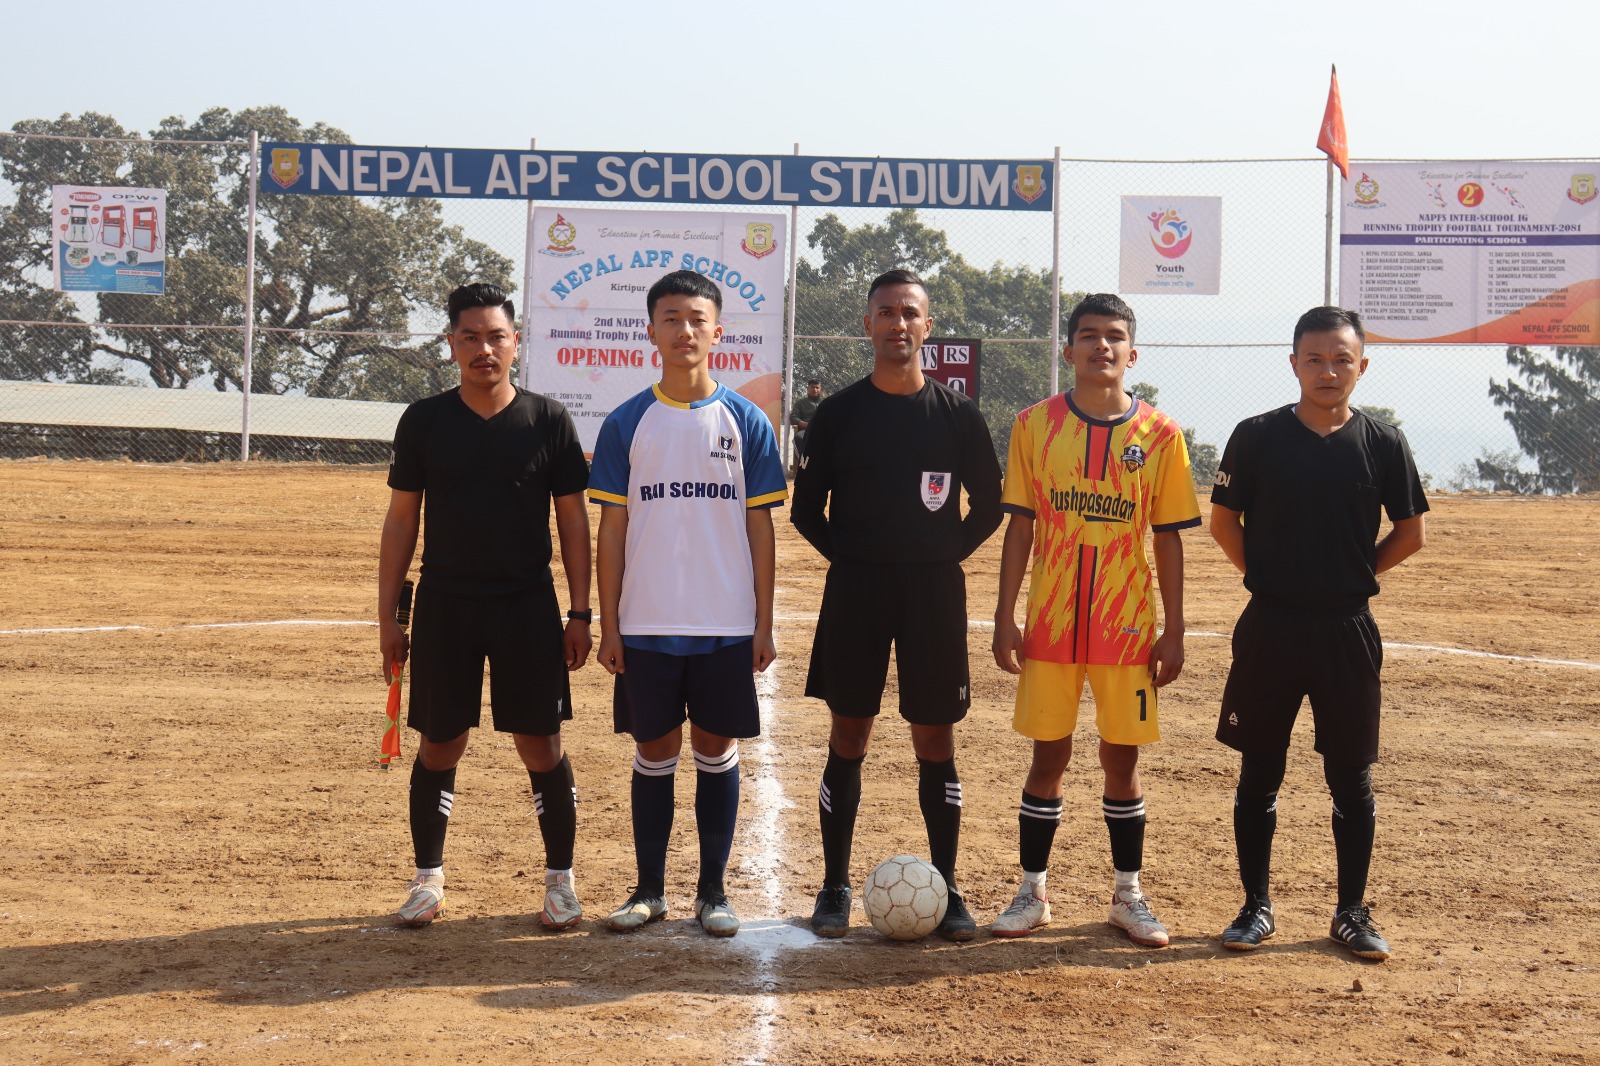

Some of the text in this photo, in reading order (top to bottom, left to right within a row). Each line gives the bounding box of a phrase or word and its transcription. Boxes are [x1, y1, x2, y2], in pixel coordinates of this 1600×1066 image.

[310, 148, 1009, 207] NEPAL APF SCHOOL STADIUM
[1419, 213, 1447, 222] NAPFS
[1449, 213, 1515, 222] INTER-SCHOOL
[1363, 223, 1581, 232] RUNNING TROPHY FOOTBALL TOURNAMENT-2081
[639, 229, 651, 241] for
[652, 229, 681, 239] Human
[1415, 236, 1527, 244] PARTICIPATING SCHOOLS
[1155, 264, 1185, 273] Youth
[550, 249, 766, 312] NEPAL APF SCHOOL
[610, 282, 648, 294] Kirtipur,
[594, 317, 645, 328] 2nd NAPFS
[1522, 324, 1591, 333] NEPAL APF SCHOOL
[550, 328, 592, 341] Running
[594, 329, 629, 342] Trophy
[720, 334, 763, 345] ent-2081
[557, 347, 643, 367] OPENING
[921, 346, 937, 368] VS
[946, 347, 968, 362] RS
[640, 481, 738, 501] RAI SCHOOL
[1136, 688, 1147, 722] 1
